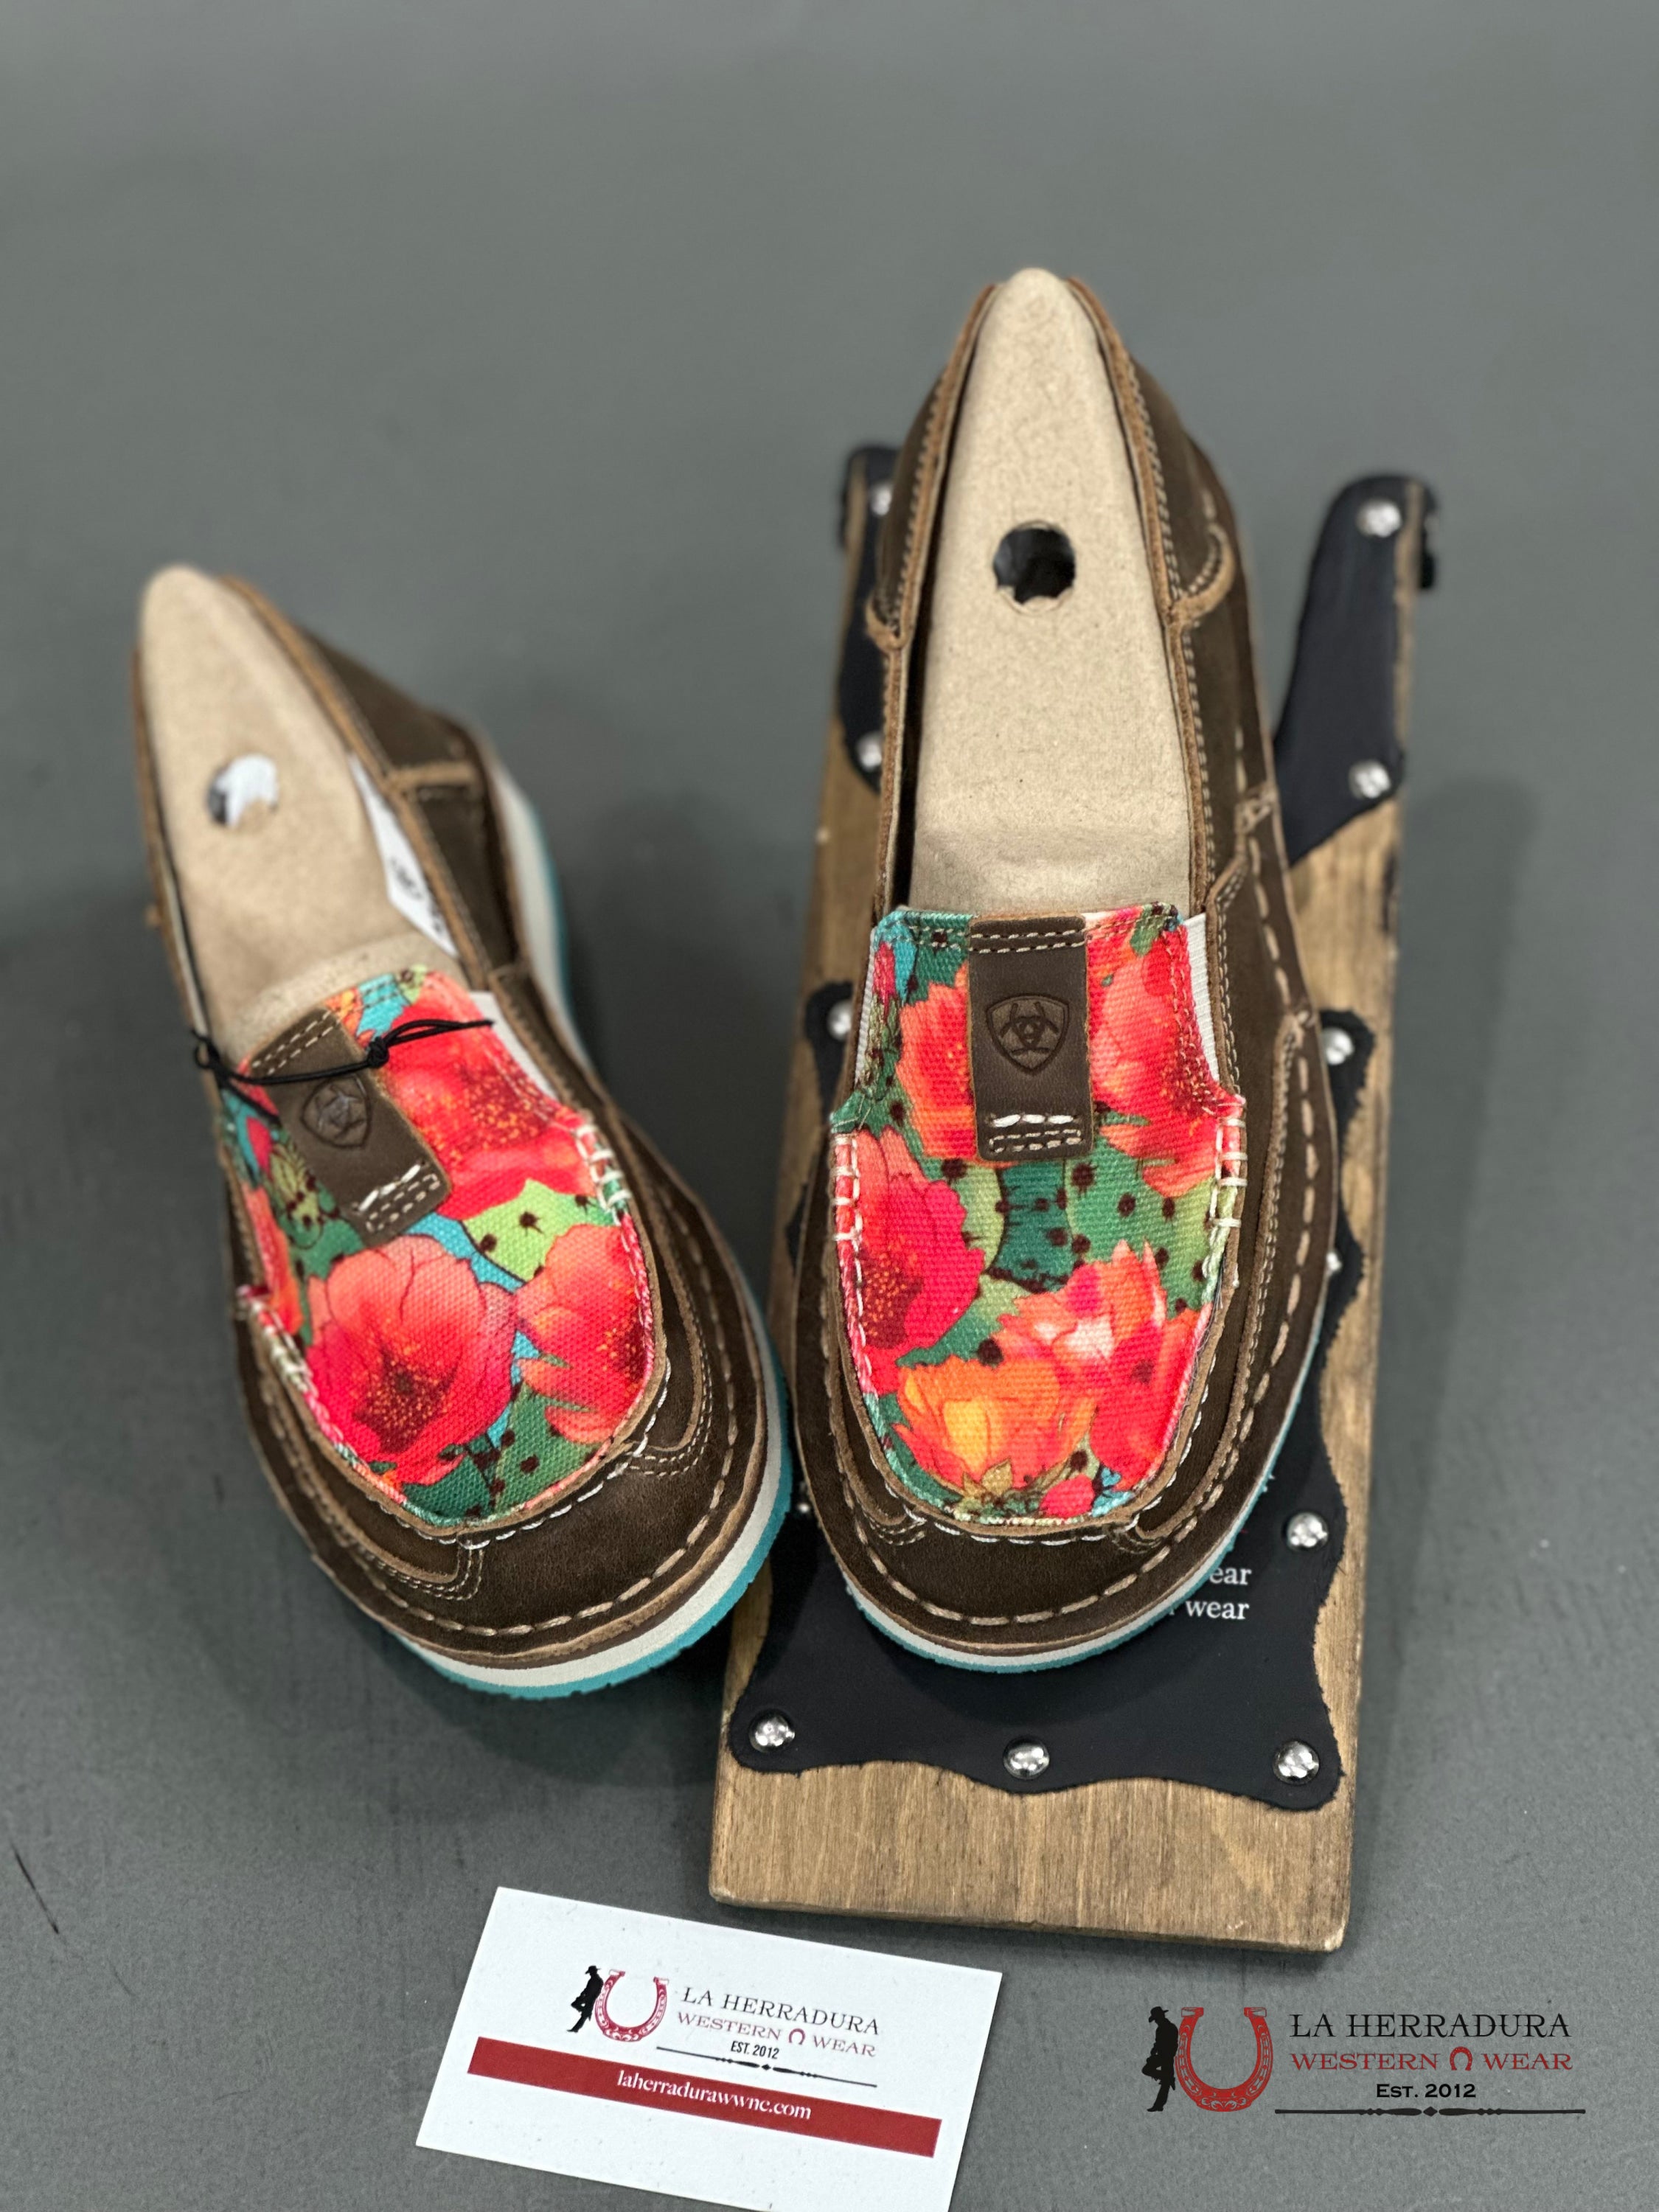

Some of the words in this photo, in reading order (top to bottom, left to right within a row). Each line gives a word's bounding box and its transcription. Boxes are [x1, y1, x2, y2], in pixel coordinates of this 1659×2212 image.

[1208, 1567, 1252, 1585] ear
[1185, 1600, 1250, 1620] wear
[682, 1986, 713, 2006] LA
[722, 1994, 880, 2036] HERRADURA
[677, 2011, 782, 2042] WESTERN
[812, 2035, 877, 2058] WEAR
[730, 2040, 750, 2055] EST.
[752, 2044, 780, 2060] 2012
[616, 2069, 812, 2121] laherradurawwnc.com
